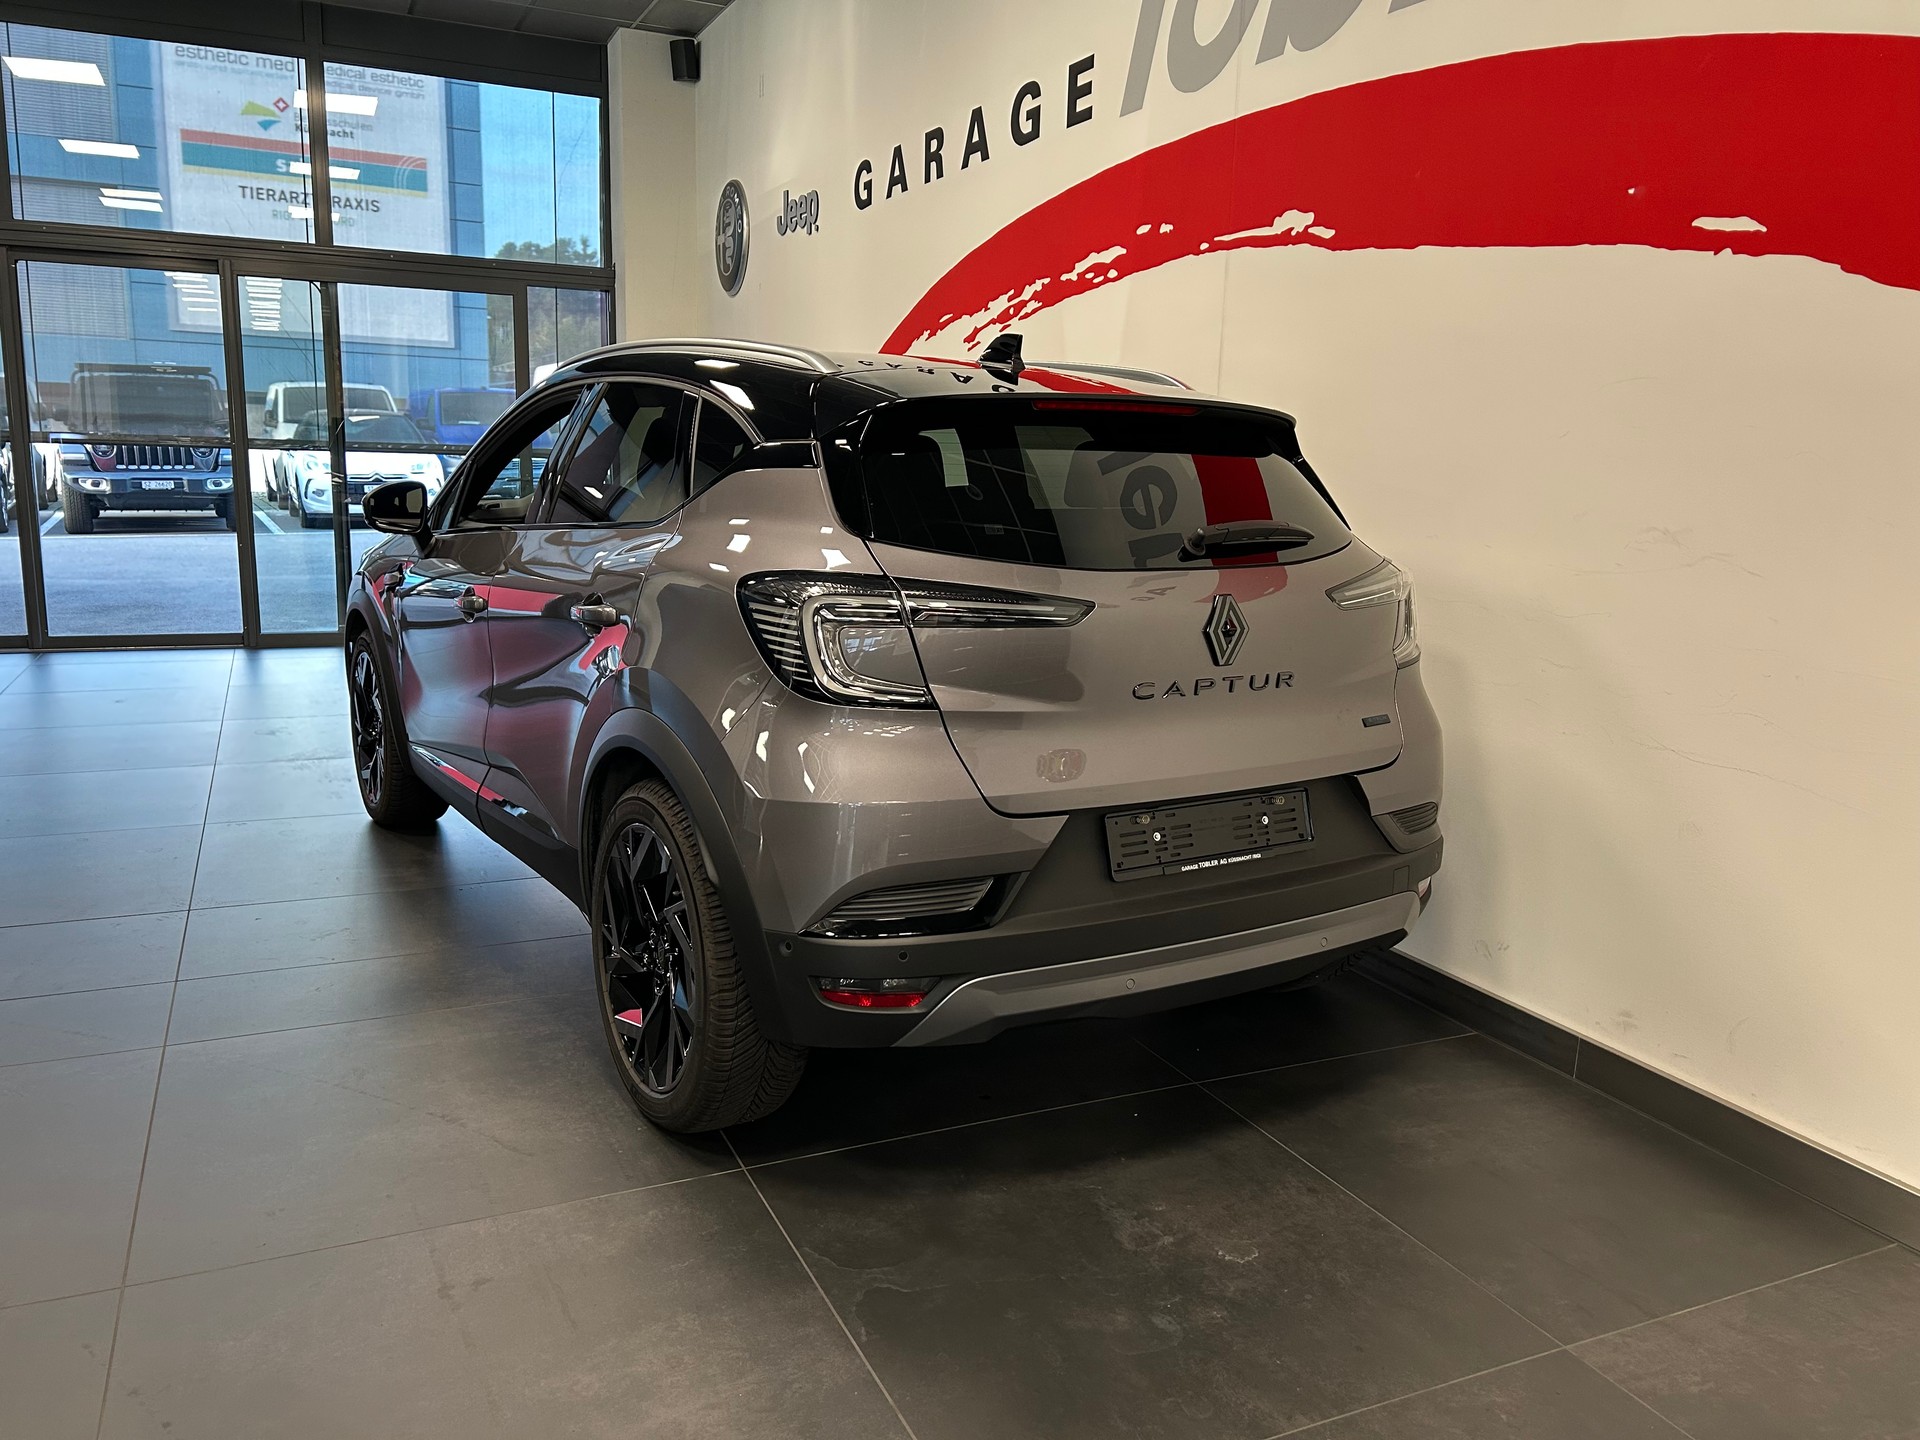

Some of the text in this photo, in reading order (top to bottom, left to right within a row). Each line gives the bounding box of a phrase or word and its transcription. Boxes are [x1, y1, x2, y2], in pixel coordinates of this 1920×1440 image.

[175, 45, 249, 66] esthetic
[325, 64, 424, 89] edical esthetic
[853, 53, 1096, 211] GARAGE
[238, 185, 381, 213] TIERARZRAXIS
[776, 189, 820, 236] Jeep
[1132, 670, 1295, 700] CAPTUR
[1181, 863, 1199, 872] GARAGE
[1198, 859, 1219, 868] TOBLER
